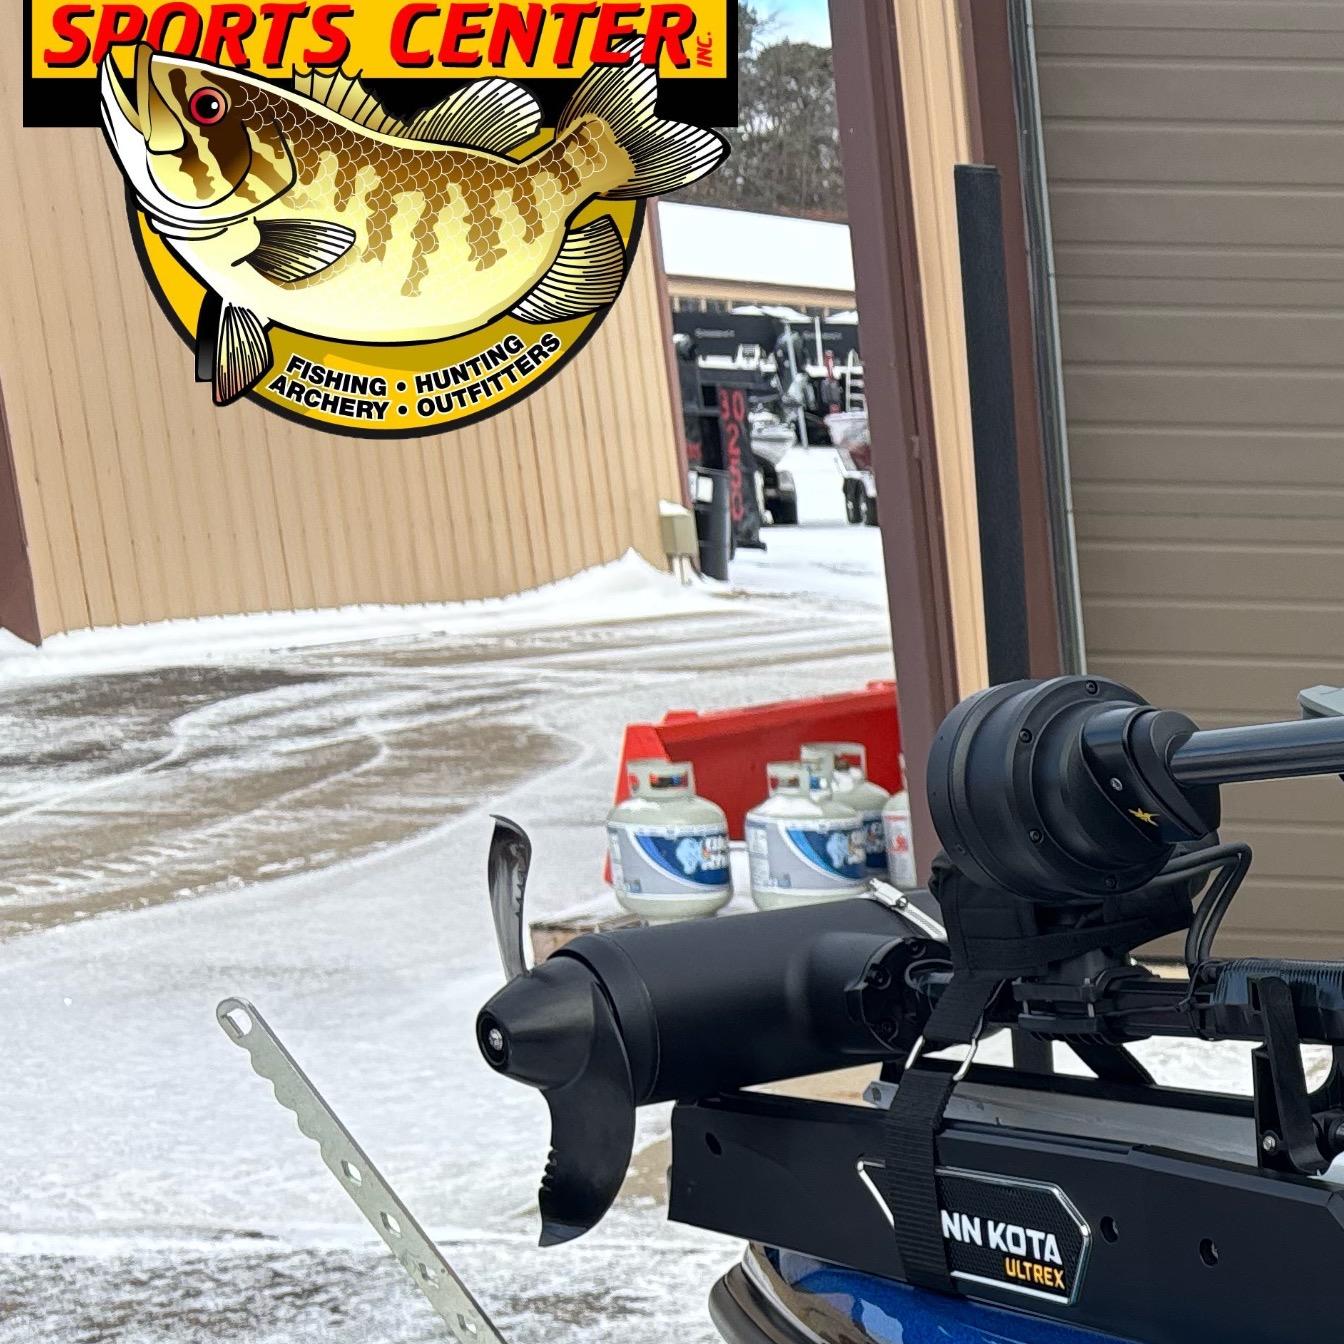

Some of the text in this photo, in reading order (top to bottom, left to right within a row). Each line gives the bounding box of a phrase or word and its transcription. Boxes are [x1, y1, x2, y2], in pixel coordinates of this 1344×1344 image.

[941, 1209, 1063, 1266] NN KOTA
[1005, 1257, 1066, 1291] ULTREX
